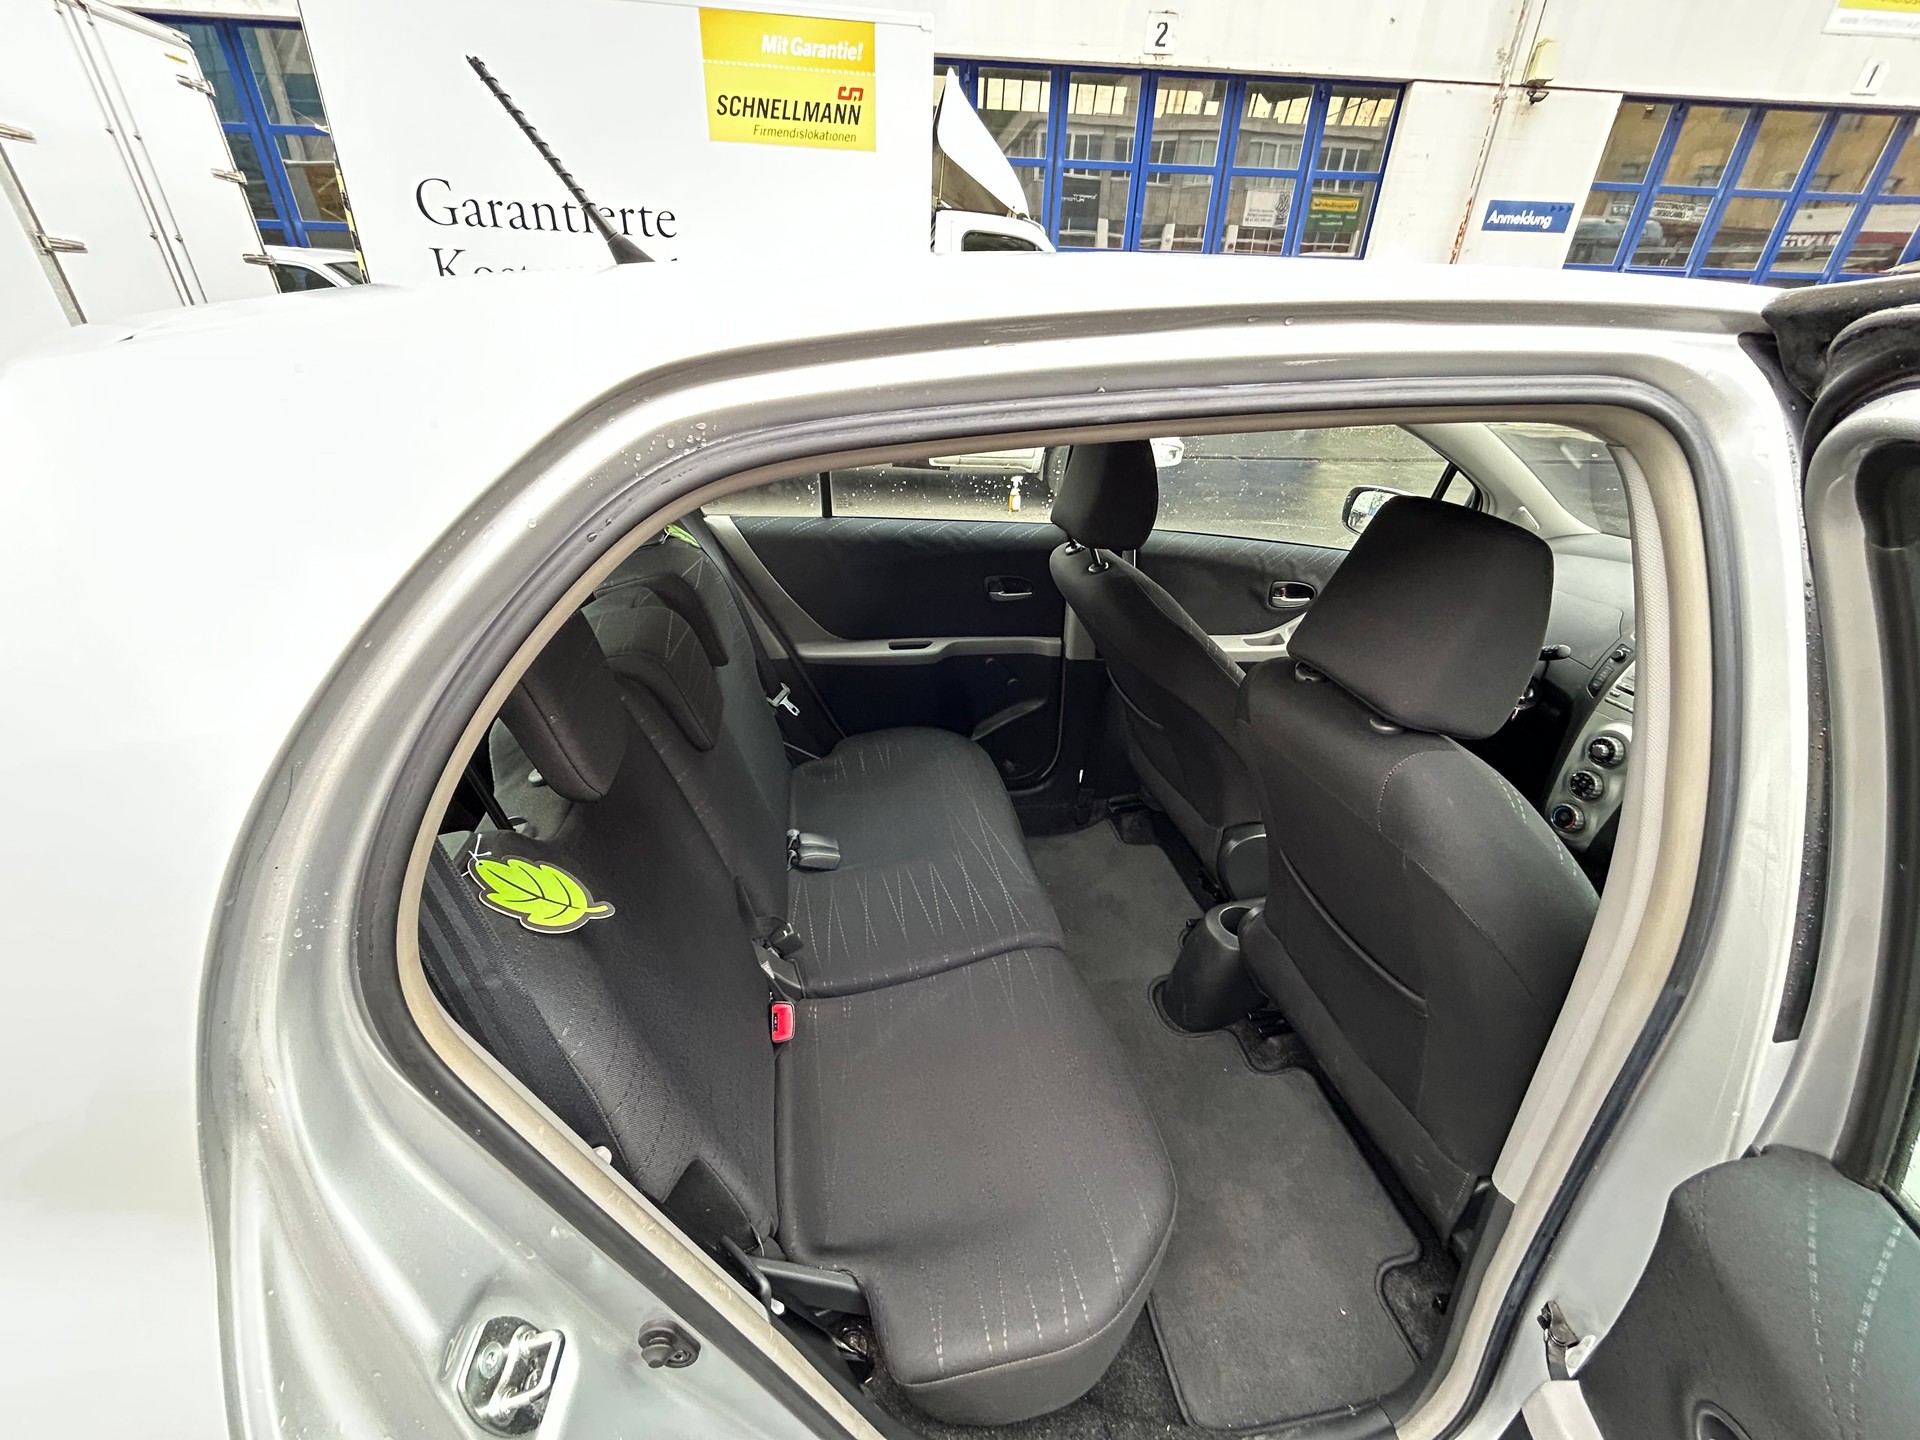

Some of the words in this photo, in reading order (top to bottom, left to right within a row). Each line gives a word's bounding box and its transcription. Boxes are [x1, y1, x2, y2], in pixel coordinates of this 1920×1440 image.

[761, 34, 788, 55] Mit
[790, 37, 864, 62] Garantie!
[1154, 21, 1169, 48] 2
[716, 94, 862, 125] SCHNELLMANN
[753, 124, 857, 143] Firmendislokationen
[1486, 209, 1553, 229] Anmeldung
